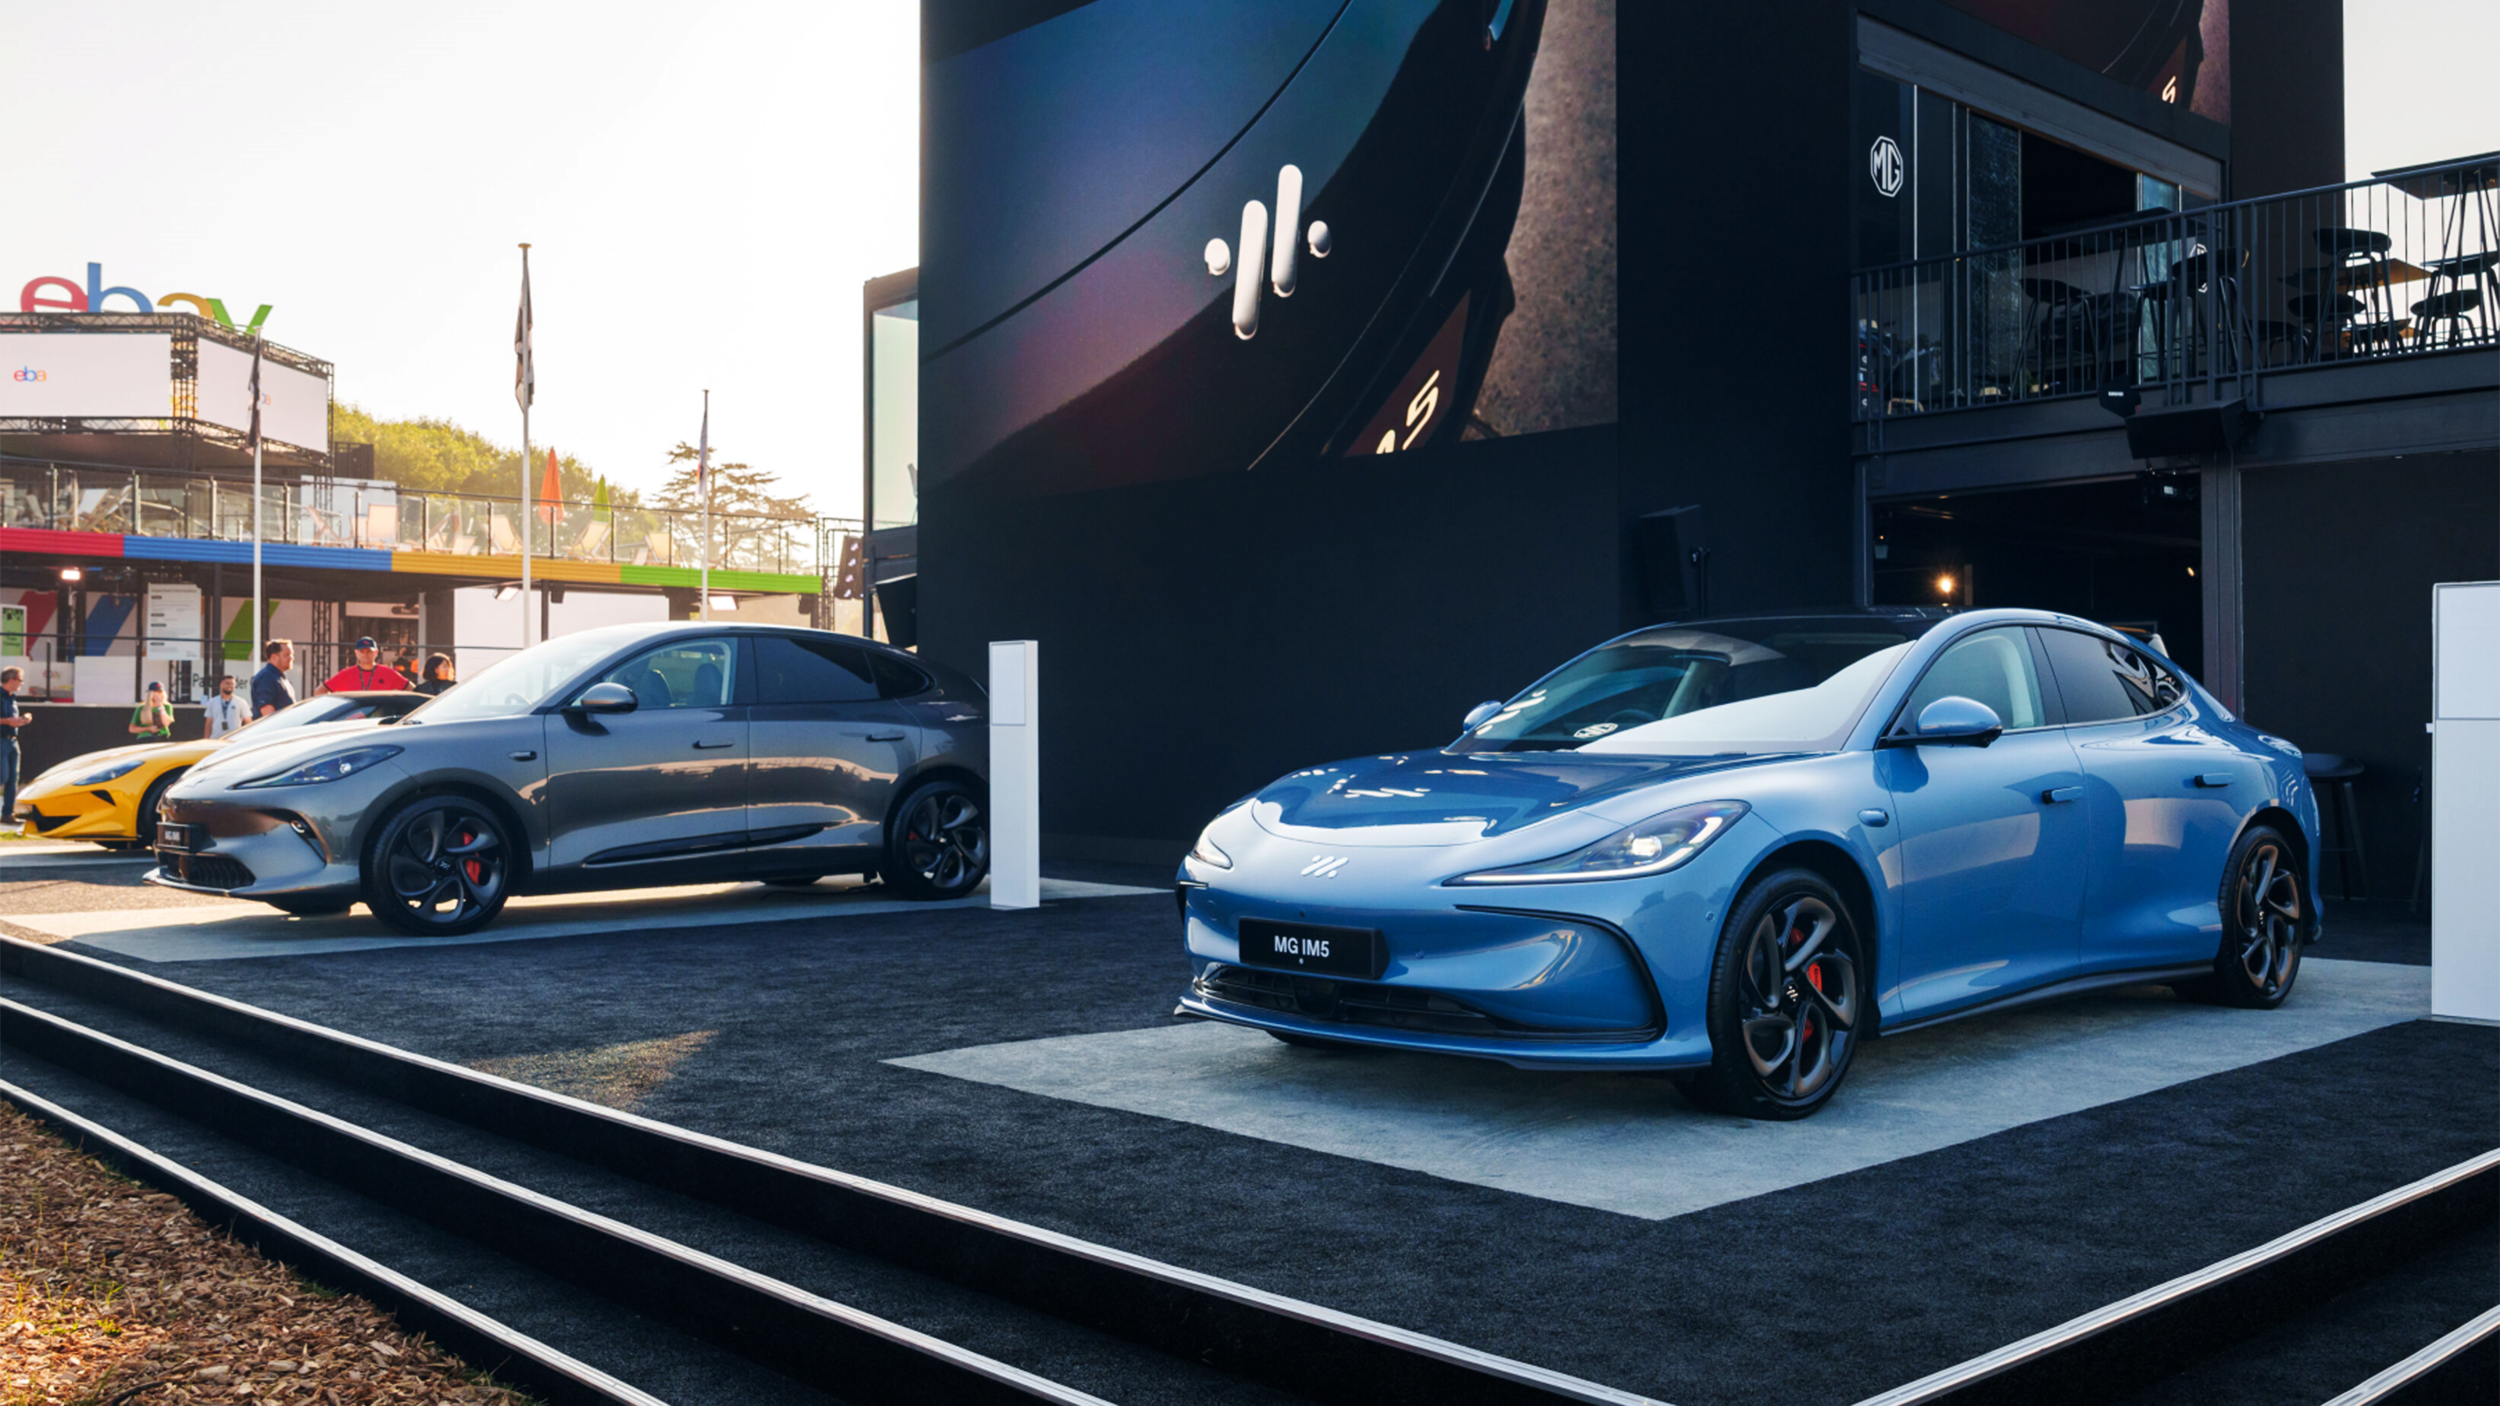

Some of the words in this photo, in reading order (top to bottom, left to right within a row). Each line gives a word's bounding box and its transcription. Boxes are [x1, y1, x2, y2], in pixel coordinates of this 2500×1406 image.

[1873, 141, 1901, 192] MG
[20, 262, 274, 335] ebay
[1274, 935, 1298, 954] MG
[1302, 938, 1330, 958] IM5
